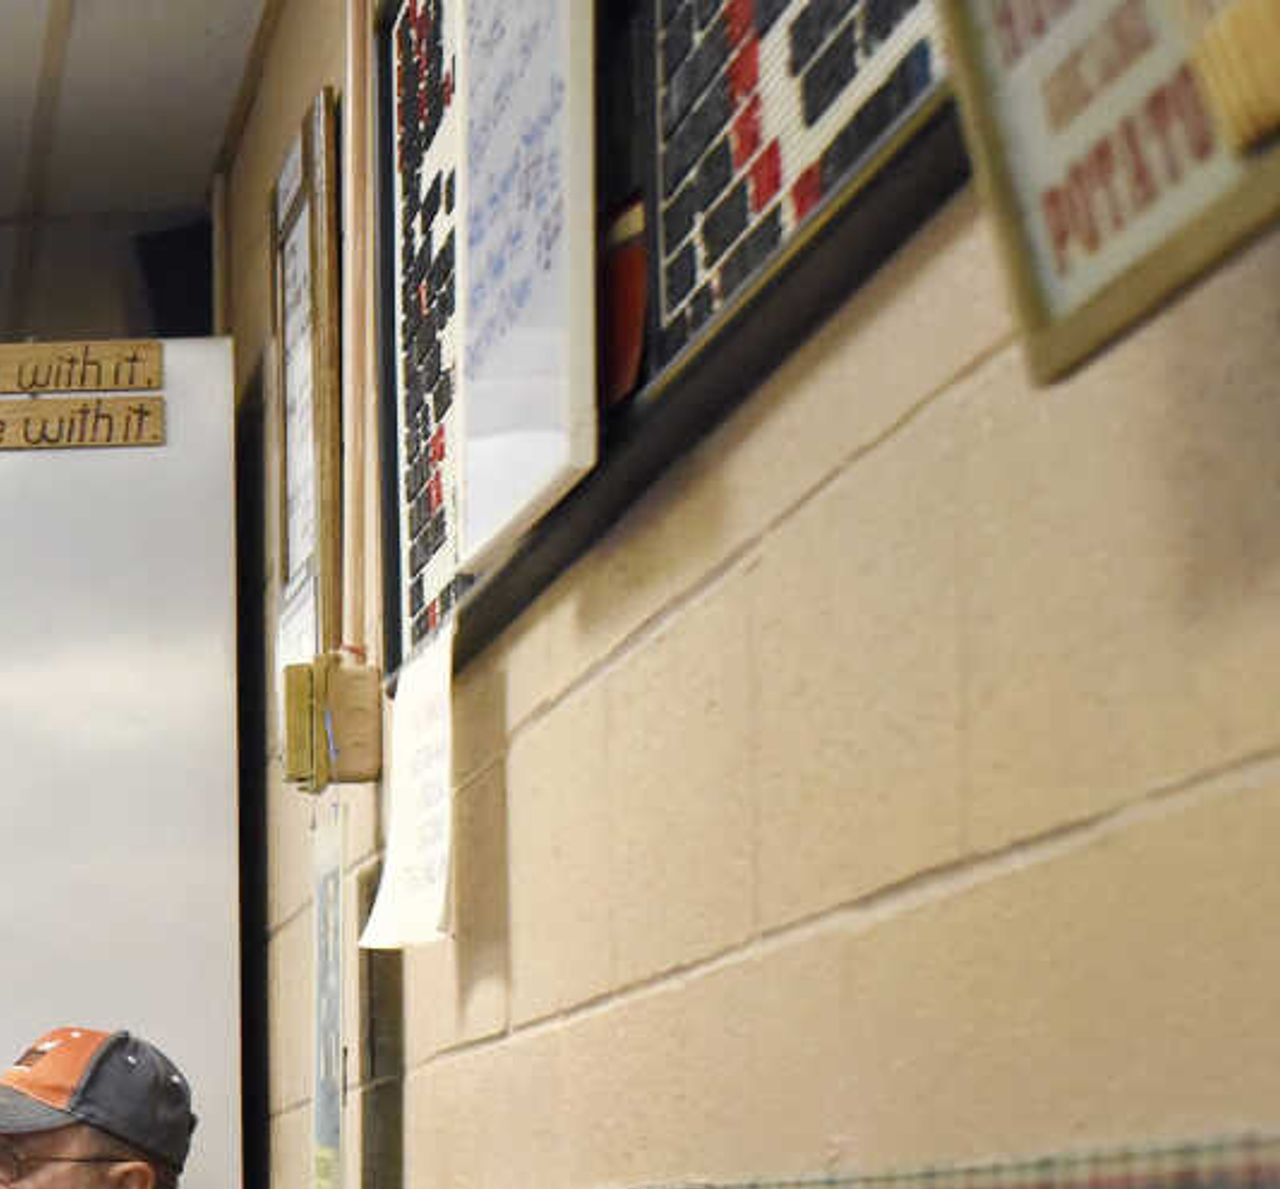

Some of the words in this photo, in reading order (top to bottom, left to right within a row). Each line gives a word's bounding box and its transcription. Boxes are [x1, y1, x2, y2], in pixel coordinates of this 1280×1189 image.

[1042, 62, 1214, 278] POTATO
[17, 345, 102, 388] with
[111, 351, 157, 388] it.
[22, 400, 114, 444] with
